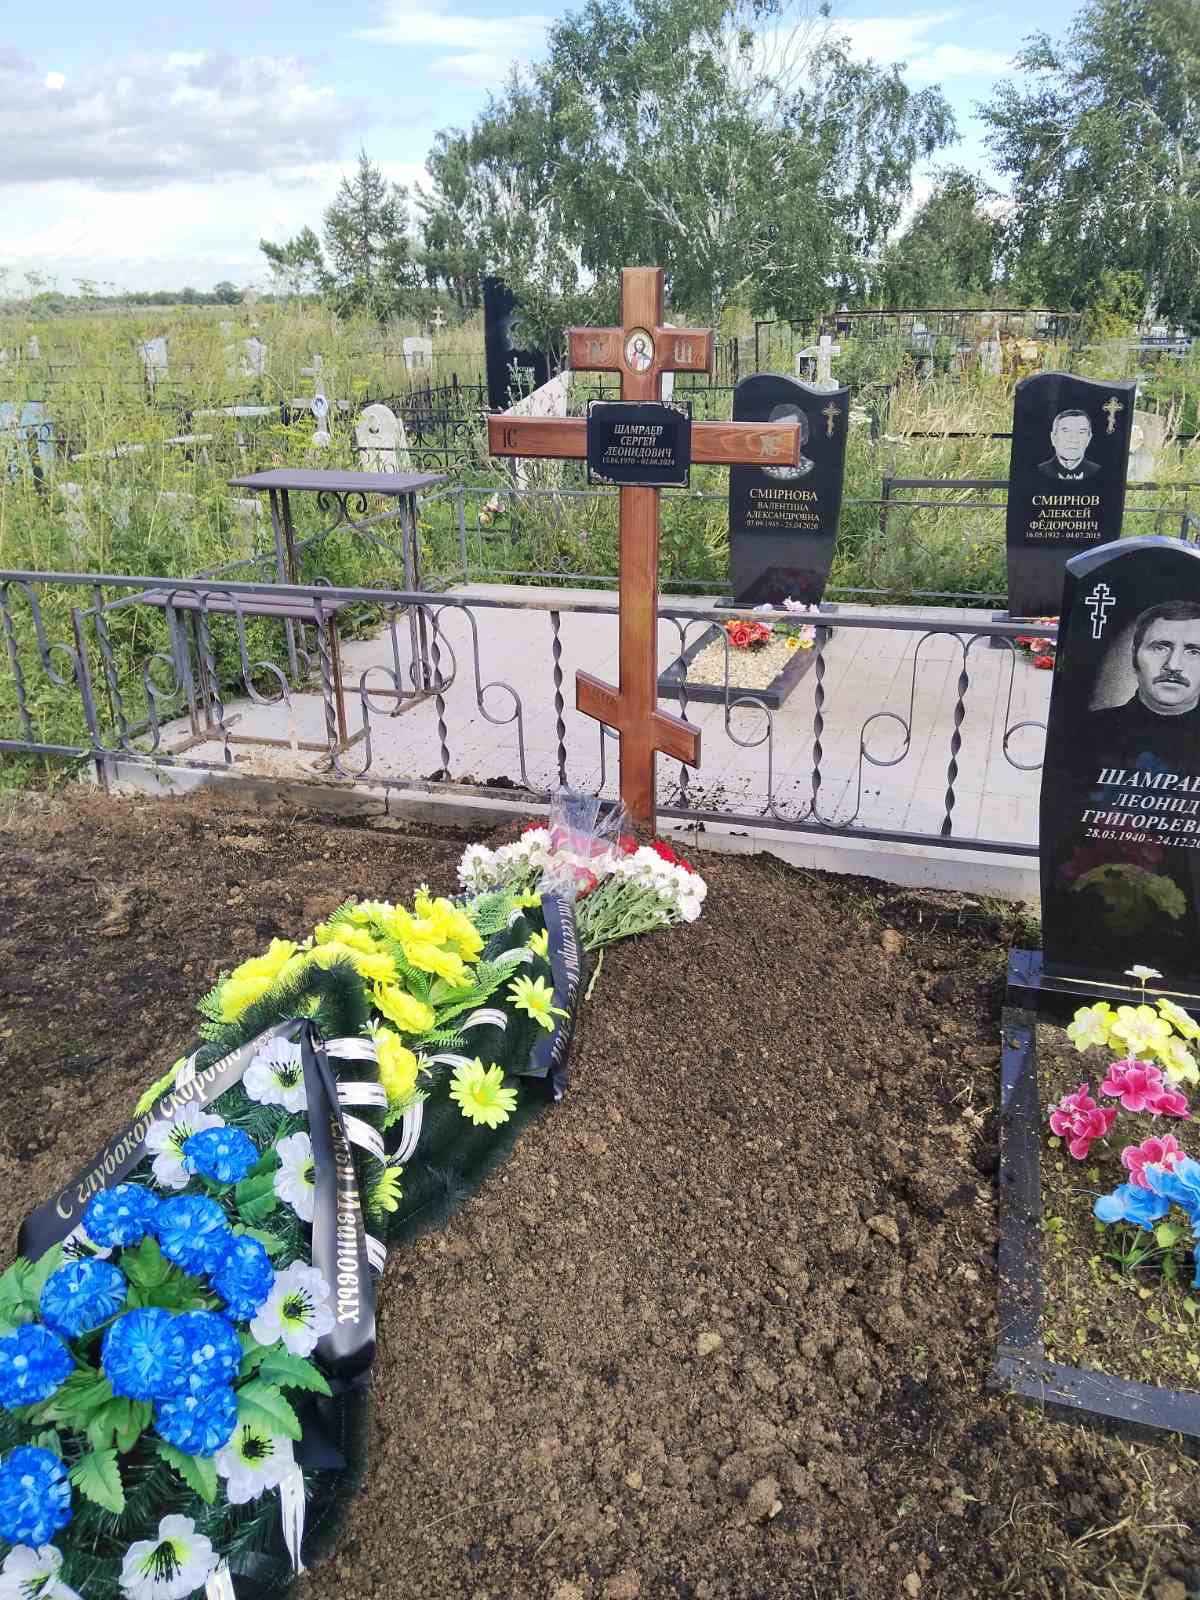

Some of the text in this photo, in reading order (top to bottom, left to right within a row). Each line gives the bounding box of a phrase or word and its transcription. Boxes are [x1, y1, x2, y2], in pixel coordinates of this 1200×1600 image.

[613, 424, 664, 435] ШАМРАЕВ
[620, 434, 657, 446] СЕРГЕЙ
[604, 446, 672, 458] ЛЕОНИДОВИЧ
[750, 488, 818, 501] СМИРНОВА
[1031, 495, 1100, 506] СМИРНОВ
[758, 501, 809, 511] ВАЛЕНТИНА
[746, 510, 820, 521] АЛЕКСАНДРОВНА
[1038, 507, 1091, 518] АЛЕКСЕЙ
[1029, 519, 1099, 531] ФЁДОРОВИЧ
[1112, 793, 1200, 815] ЛЕОНИД
[1080, 809, 1200, 834] ГРИГОРЬЕВ
[1085, 828, 1146, 842] 28.03.1940
[336, 1189, 361, 1324] Ивановых
